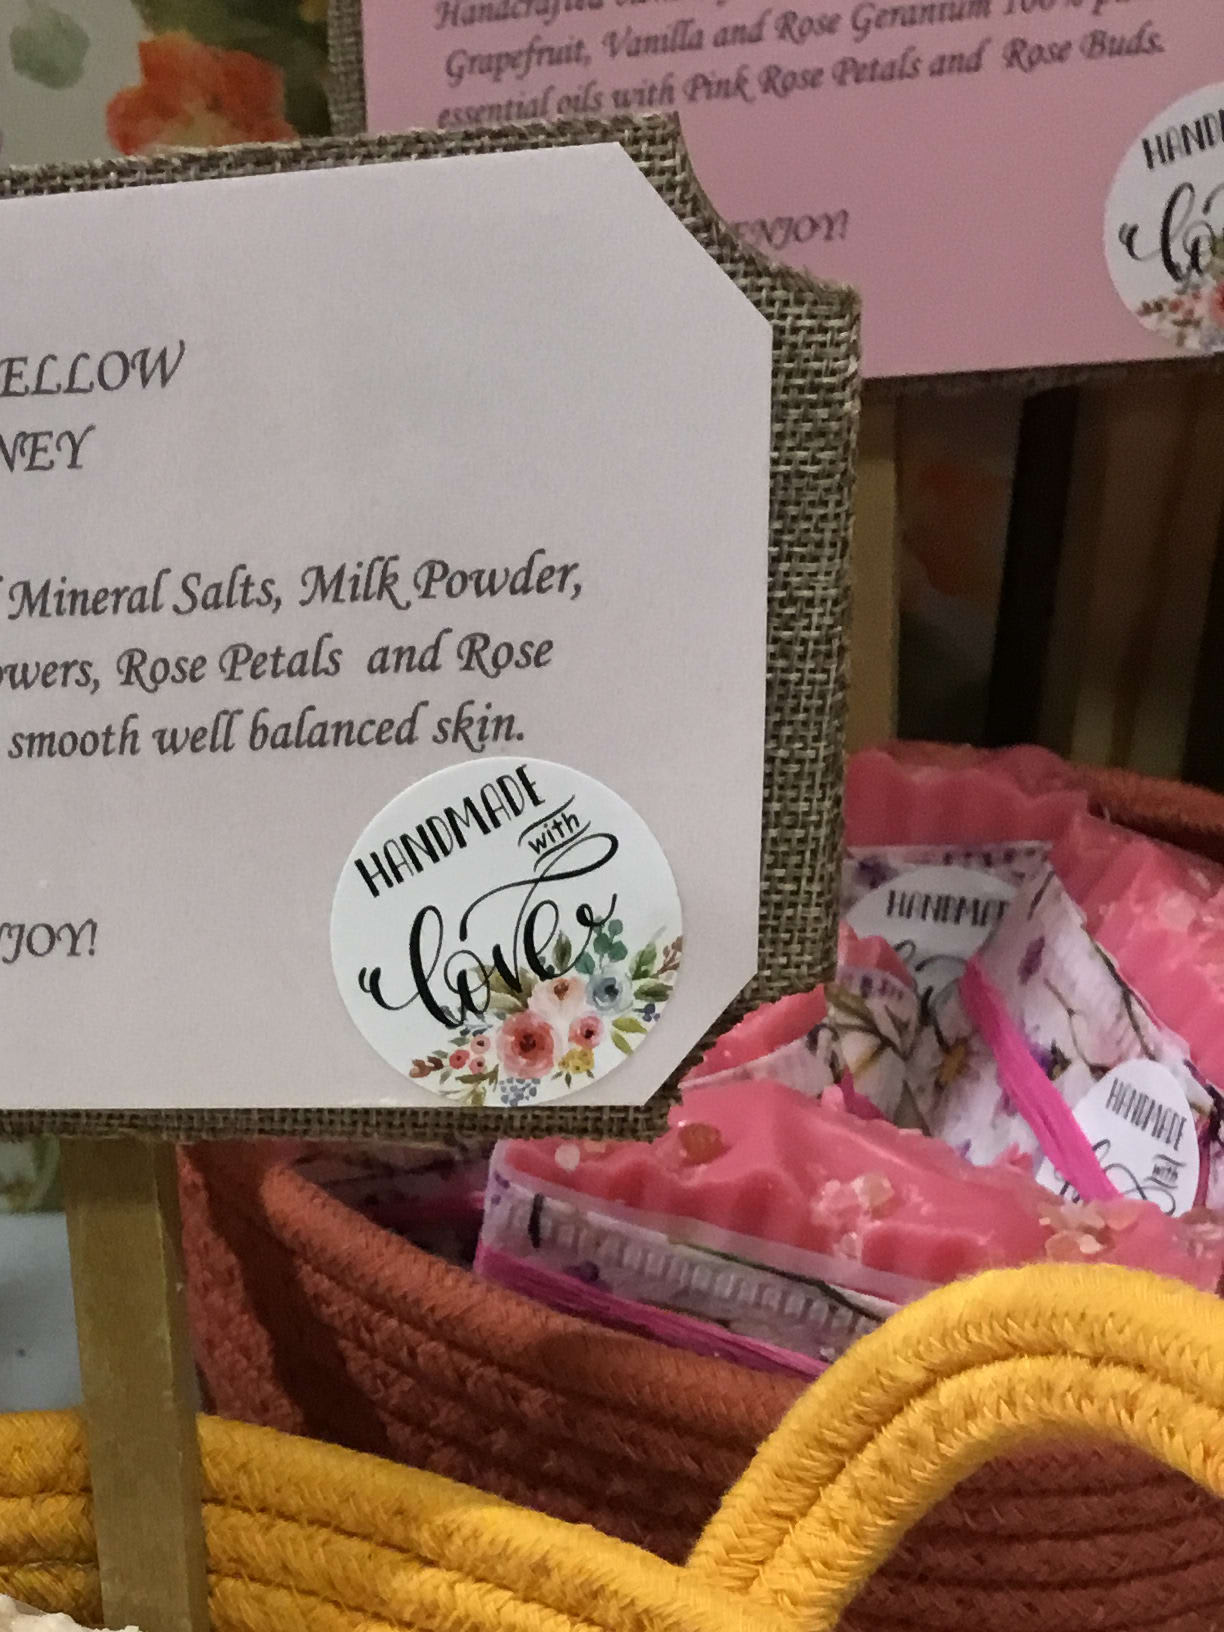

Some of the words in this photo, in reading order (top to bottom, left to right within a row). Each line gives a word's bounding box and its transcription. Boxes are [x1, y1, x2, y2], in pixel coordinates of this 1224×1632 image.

[436, 84, 555, 130] essential
[556, 78, 605, 116] oils
[611, 71, 676, 108] with
[682, 64, 755, 103] Pink
[757, 63, 823, 99] Rose
[831, 45, 922, 87] Petals
[928, 36, 992, 78] and
[1002, 36, 1073, 74] Rose
[1080, 19, 1166, 60] Buds.
[445, 35, 593, 88] Grapefruit,
[602, 18, 704, 59] Vanilla
[712, 7, 773, 48] and
[774, 10, 841, 46] Rose
[850, 0, 992, 43] Geranium
[7, 567, 172, 620] Mineral
[172, 564, 284, 615] Salts,
[298, 554, 411, 611] Milk
[412, 548, 583, 603] Powder,
[115, 645, 207, 694] Rose
[217, 631, 342, 684] Petals
[365, 626, 455, 676] and
[456, 627, 555, 678] Rose
[7, 712, 140, 763] smooth
[151, 709, 244, 757] well
[248, 701, 430, 752] balanced
[432, 700, 526, 755] skin.
[354, 764, 547, 898] HANDMADE
[526, 810, 582, 855] with
[1106, 1078, 1187, 1151] HANDMADE
